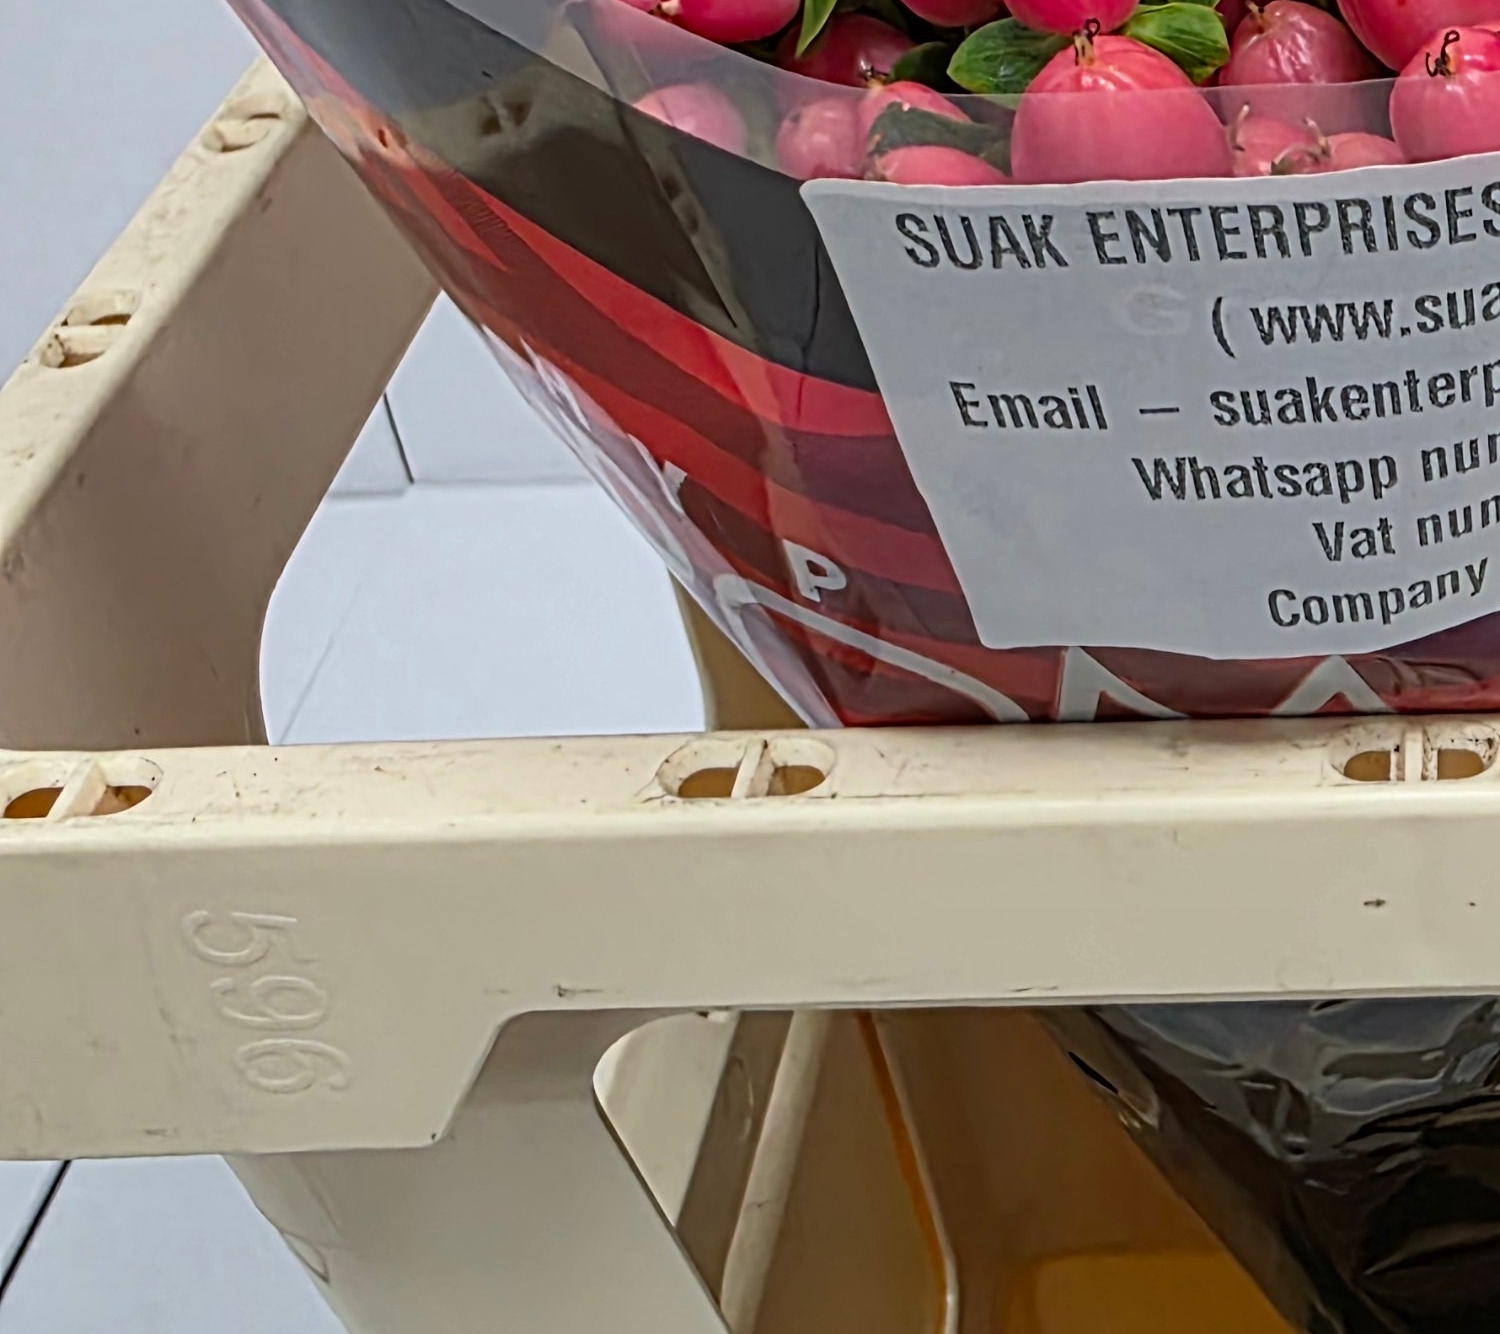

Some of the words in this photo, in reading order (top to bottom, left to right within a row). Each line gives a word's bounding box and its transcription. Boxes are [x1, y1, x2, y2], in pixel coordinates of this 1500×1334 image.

[896, 211, 1069, 269] SUAK
[949, 380, 1109, 430] Email
[1132, 454, 1399, 503] Whatsapp
[1312, 517, 1395, 562] Vat
[1268, 557, 1488, 627] Company
